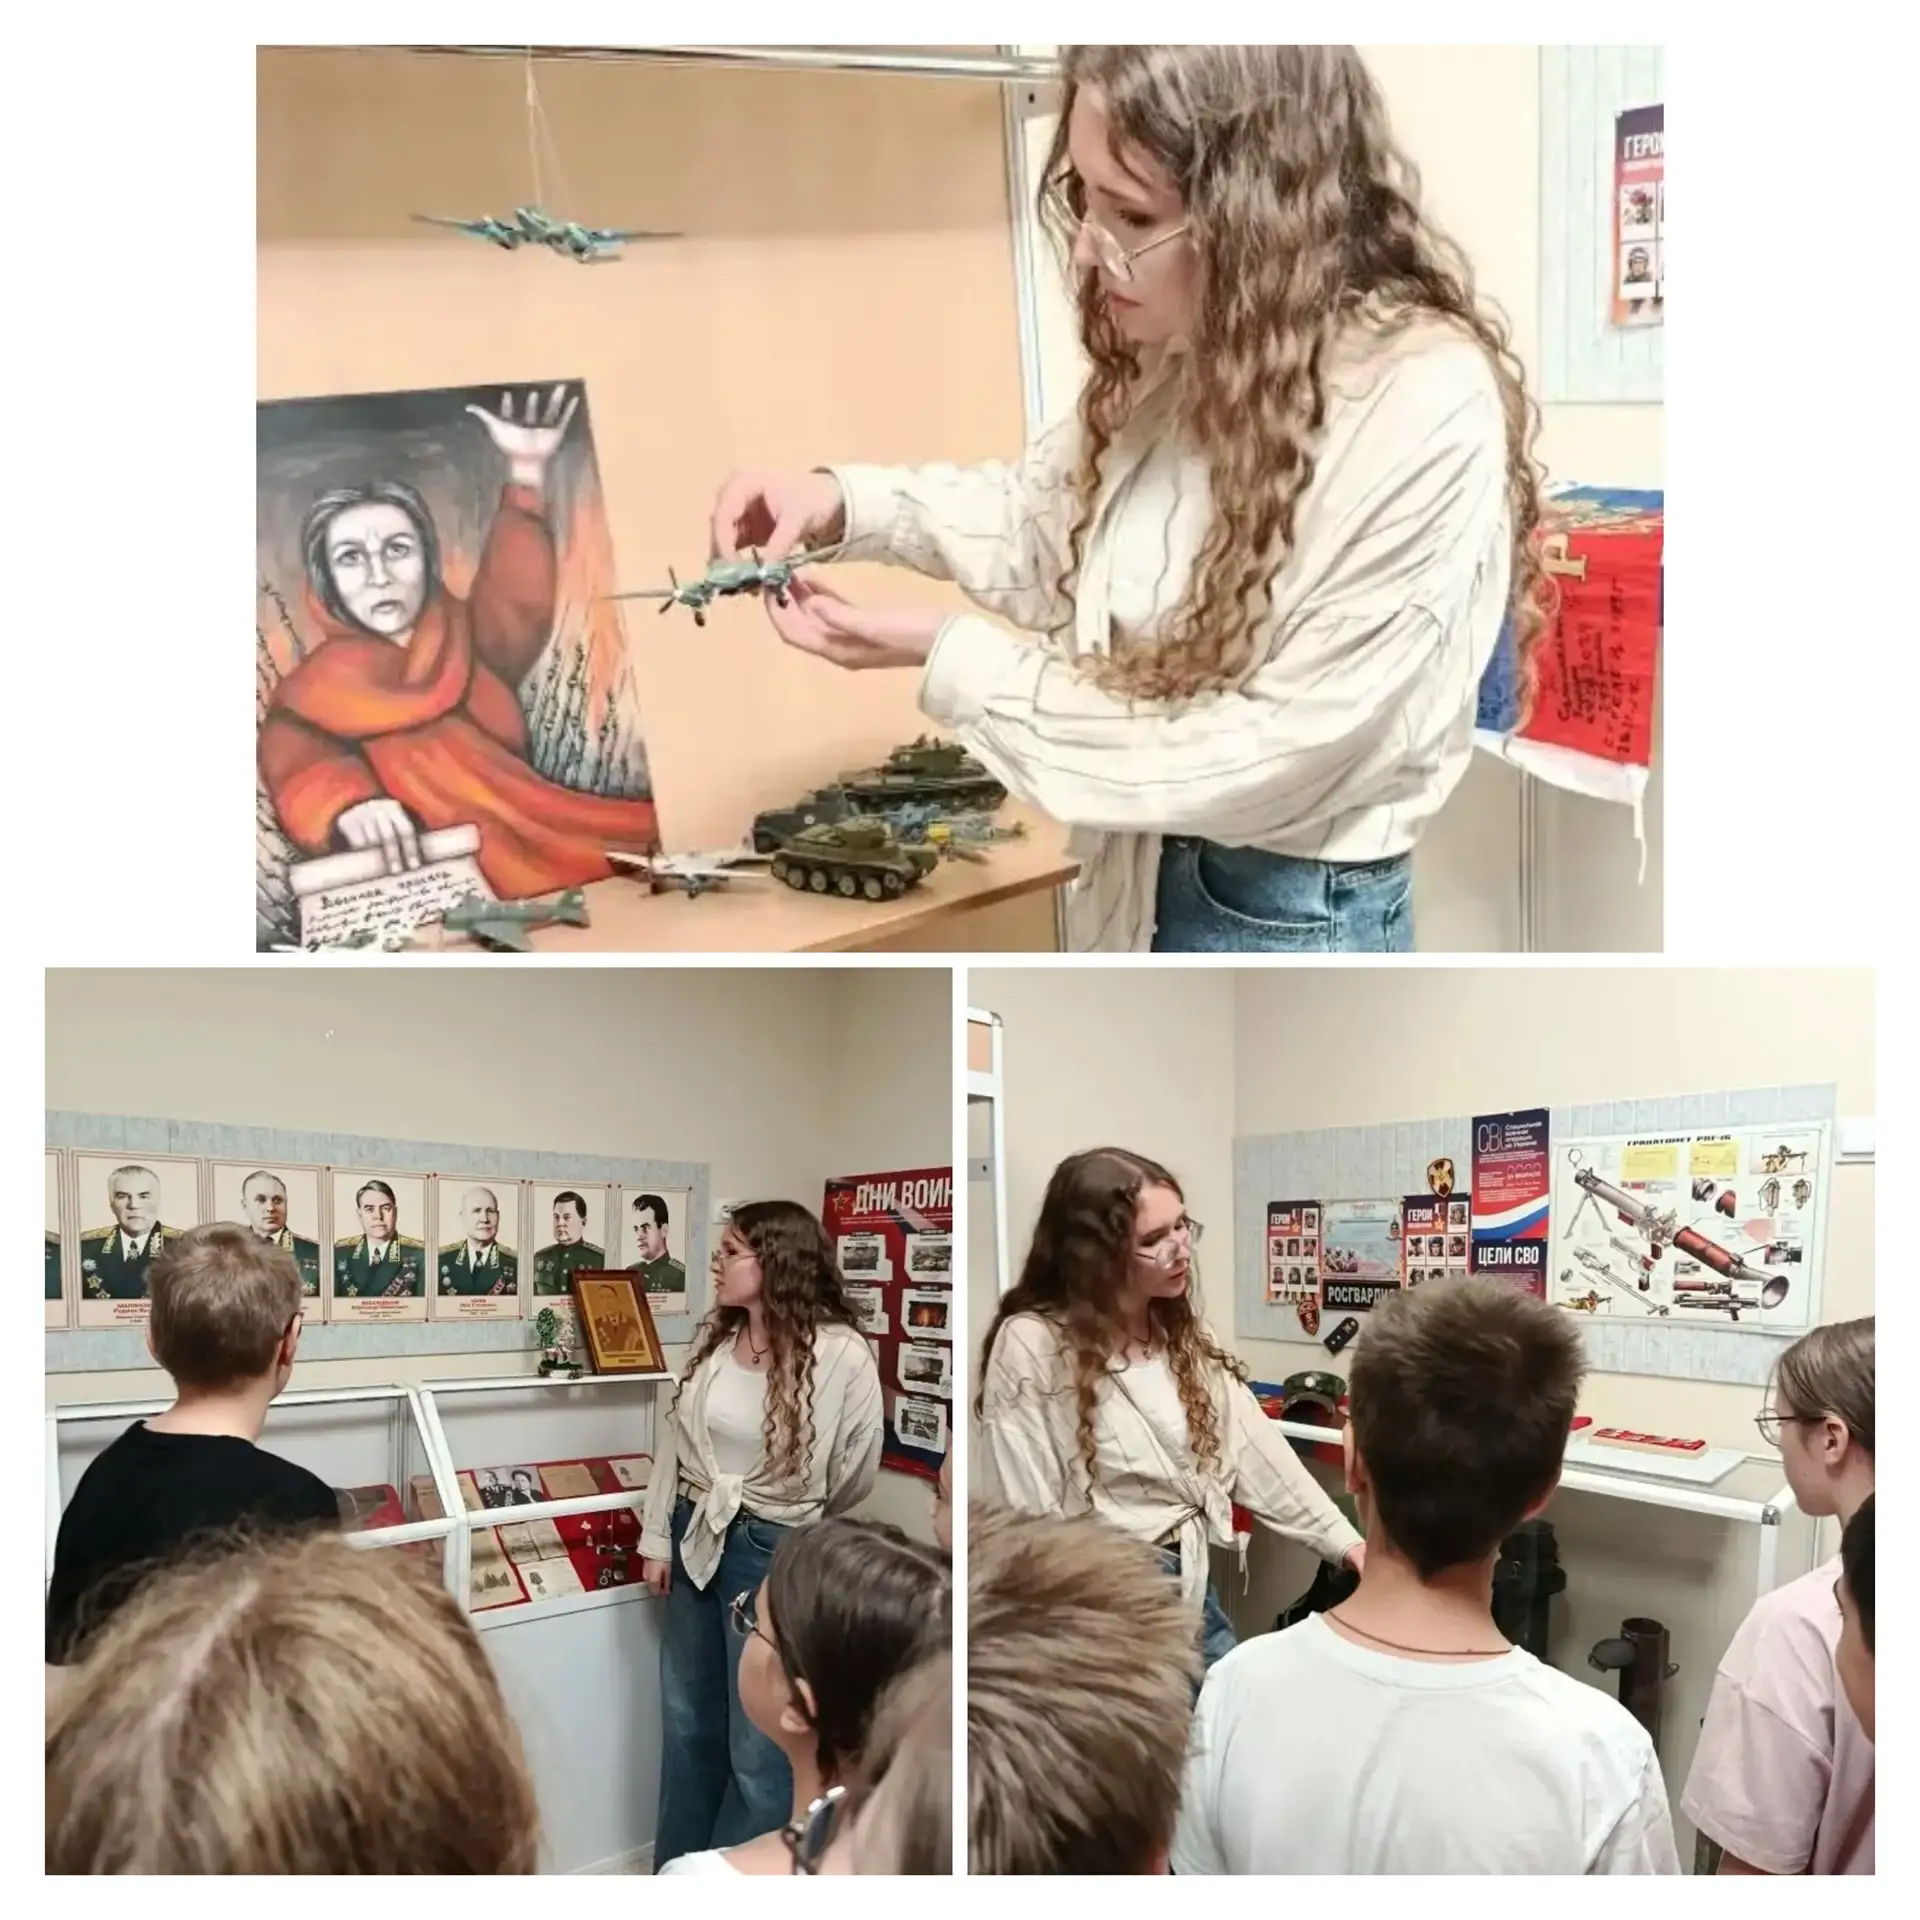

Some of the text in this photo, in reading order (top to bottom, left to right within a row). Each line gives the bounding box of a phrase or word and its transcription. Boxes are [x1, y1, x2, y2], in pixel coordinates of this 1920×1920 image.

[852, 1182, 896, 1215] ДНИ
[1271, 1213, 1290, 1225] ГЕРОИ
[1408, 1208, 1432, 1221] ГЕРОИ
[1478, 1245, 1539, 1267] ЦЕЛИ СВО
